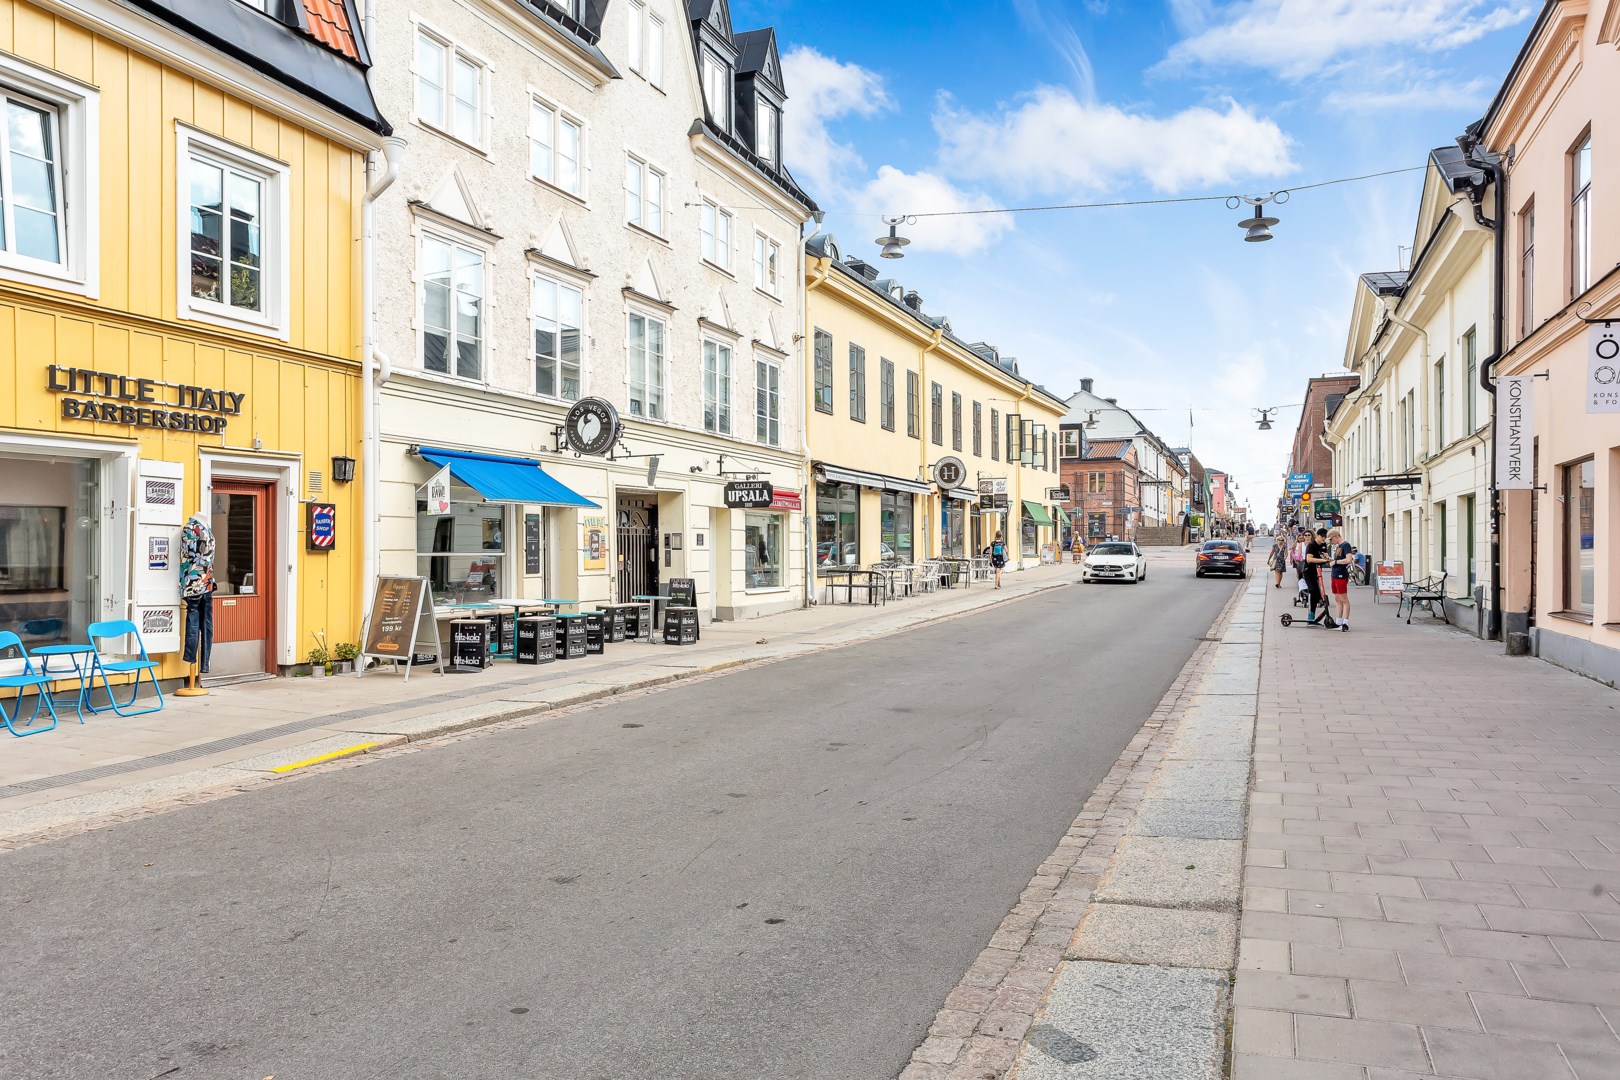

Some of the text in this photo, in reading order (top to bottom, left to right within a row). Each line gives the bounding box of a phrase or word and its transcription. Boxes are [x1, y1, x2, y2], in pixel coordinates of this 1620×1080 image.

[48, 364, 245, 414] LITTLE ITALY
[572, 404, 608, 423] LOS VEGOS
[1509, 379, 1522, 481] KONSTHANTVERK
[728, 490, 770, 502] UPSALA
[455, 633, 480, 641] fritz-kola
[454, 656, 480, 665] fritz-kola
